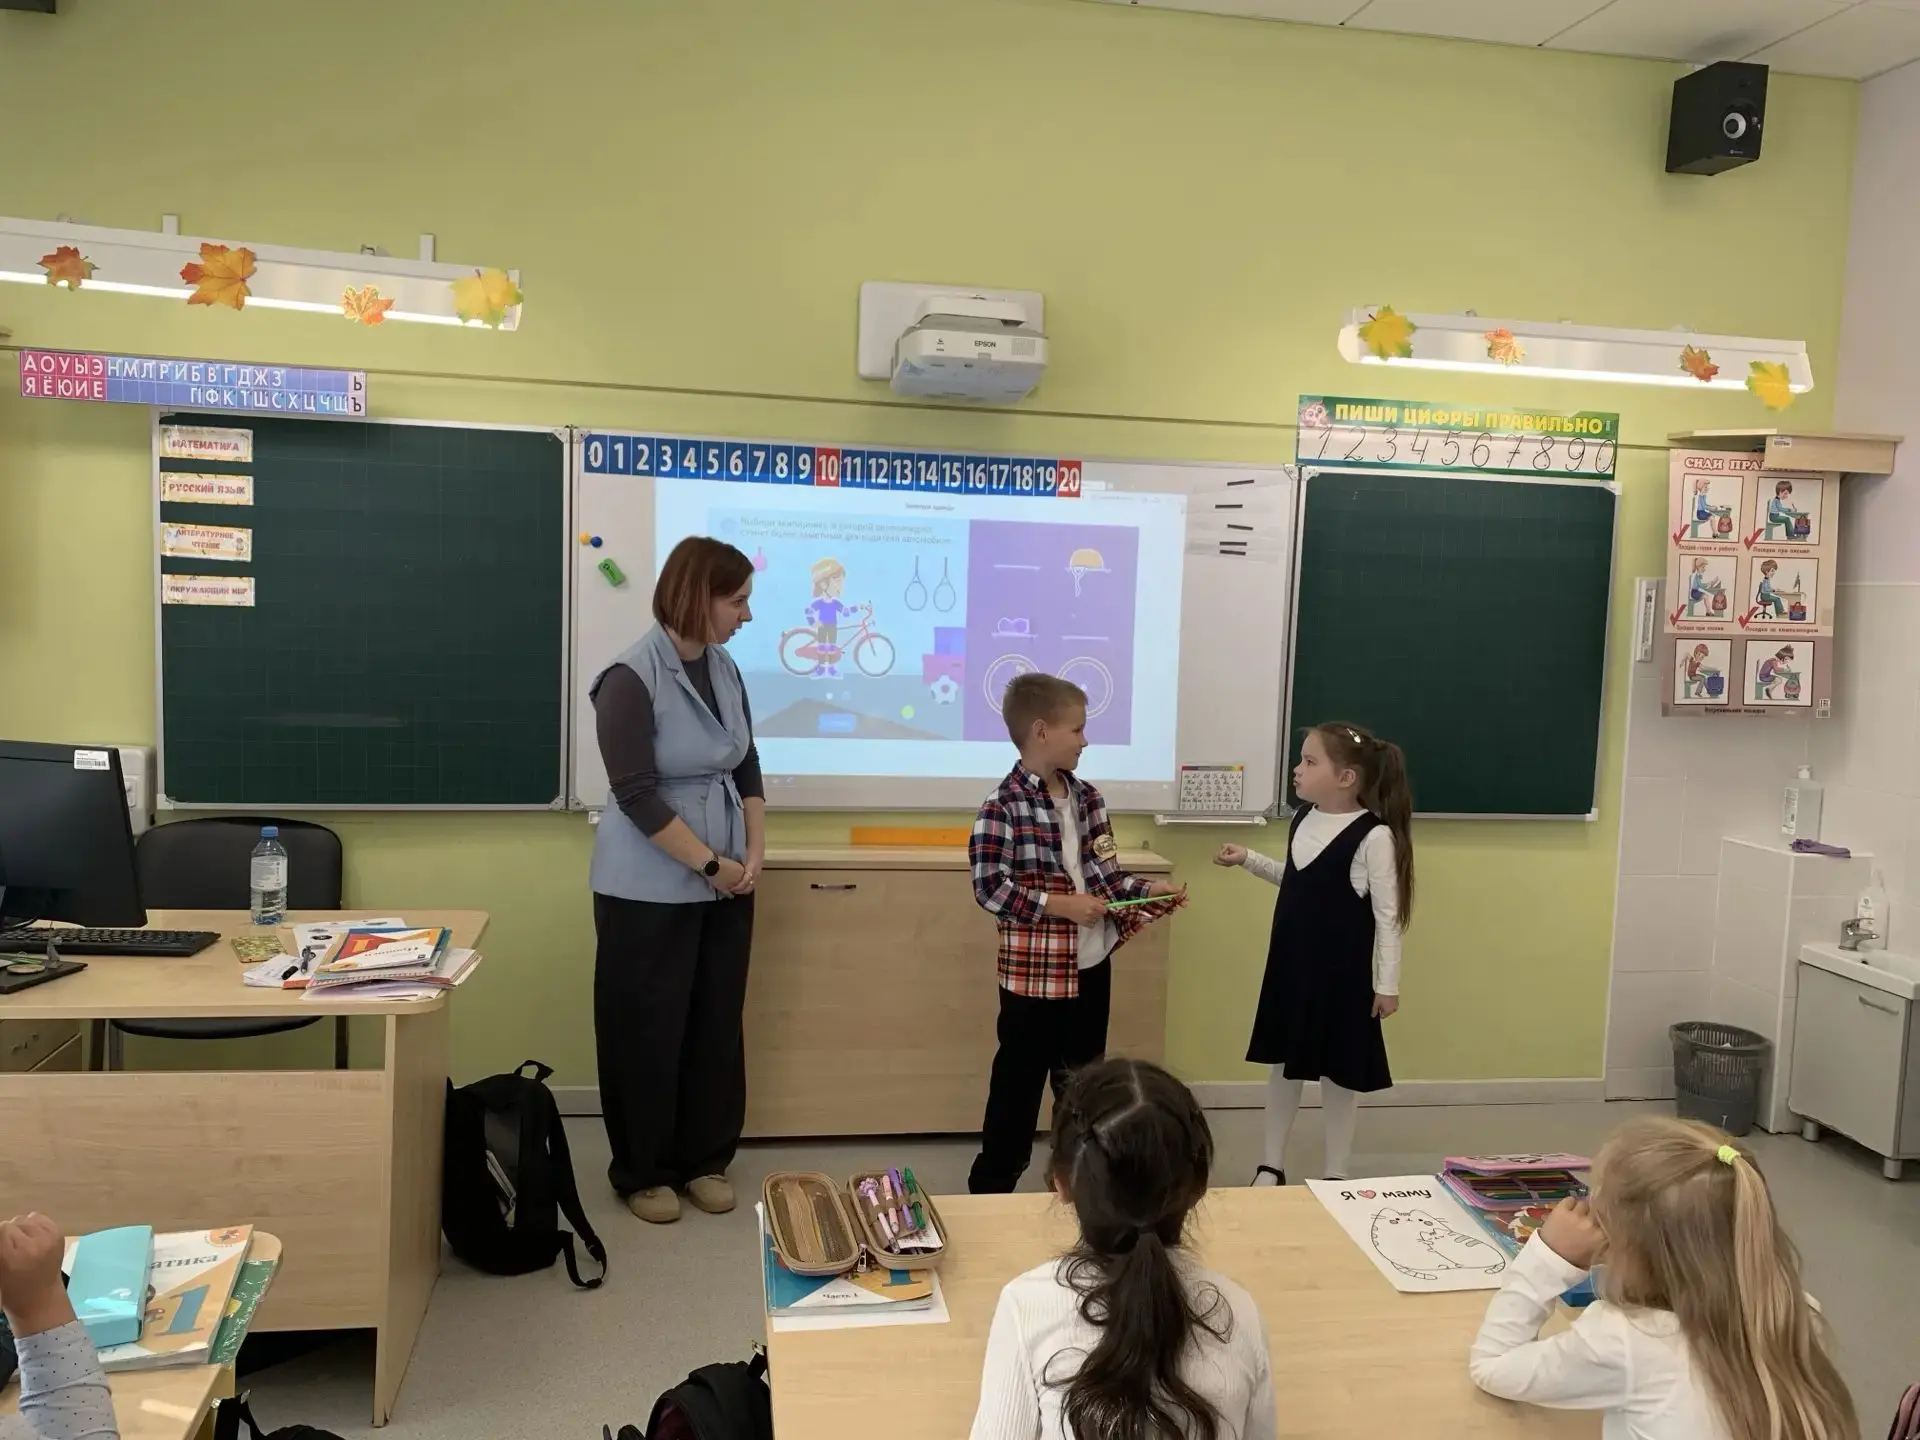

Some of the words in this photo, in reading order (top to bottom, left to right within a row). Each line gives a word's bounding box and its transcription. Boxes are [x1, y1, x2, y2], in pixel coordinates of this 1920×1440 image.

[974, 340, 996, 348] EPSON
[1336, 404, 1397, 422] ПИШИ
[1404, 407, 1479, 427] ЦИФРЫ
[172, 440, 239, 451] МАТЕМАТИКА
[589, 441, 603, 468] 0
[614, 443, 624, 469] 1
[637, 444, 649, 470] 2
[661, 446, 672, 471] 3
[683, 448, 697, 473] 4
[707, 449, 719, 474] 5
[730, 450, 743, 476] 6
[753, 451, 765, 476] 7
[775, 452, 788, 478] 8
[798, 453, 811, 479] 9
[818, 455, 838, 481] 10
[844, 456, 861, 482] 11
[868, 458, 888, 483] 12
[893, 459, 912, 485] 13
[918, 461, 938, 486] 14
[942, 462, 961, 488] 15
[966, 463, 986, 489] 16
[990, 464, 1009, 489] 17
[1013, 465, 1032, 491] 18
[1037, 466, 1056, 491] 19
[1059, 467, 1080, 492] 20
[1685, 457, 1725, 471] СИДИ
[169, 482, 213, 493] РУССКИЙ
[218, 486, 245, 494] ЯЗЫК
[176, 529, 234, 539] ЛИТЕРАТУРНОЕ
[1341, 1191, 1356, 1200] Я
